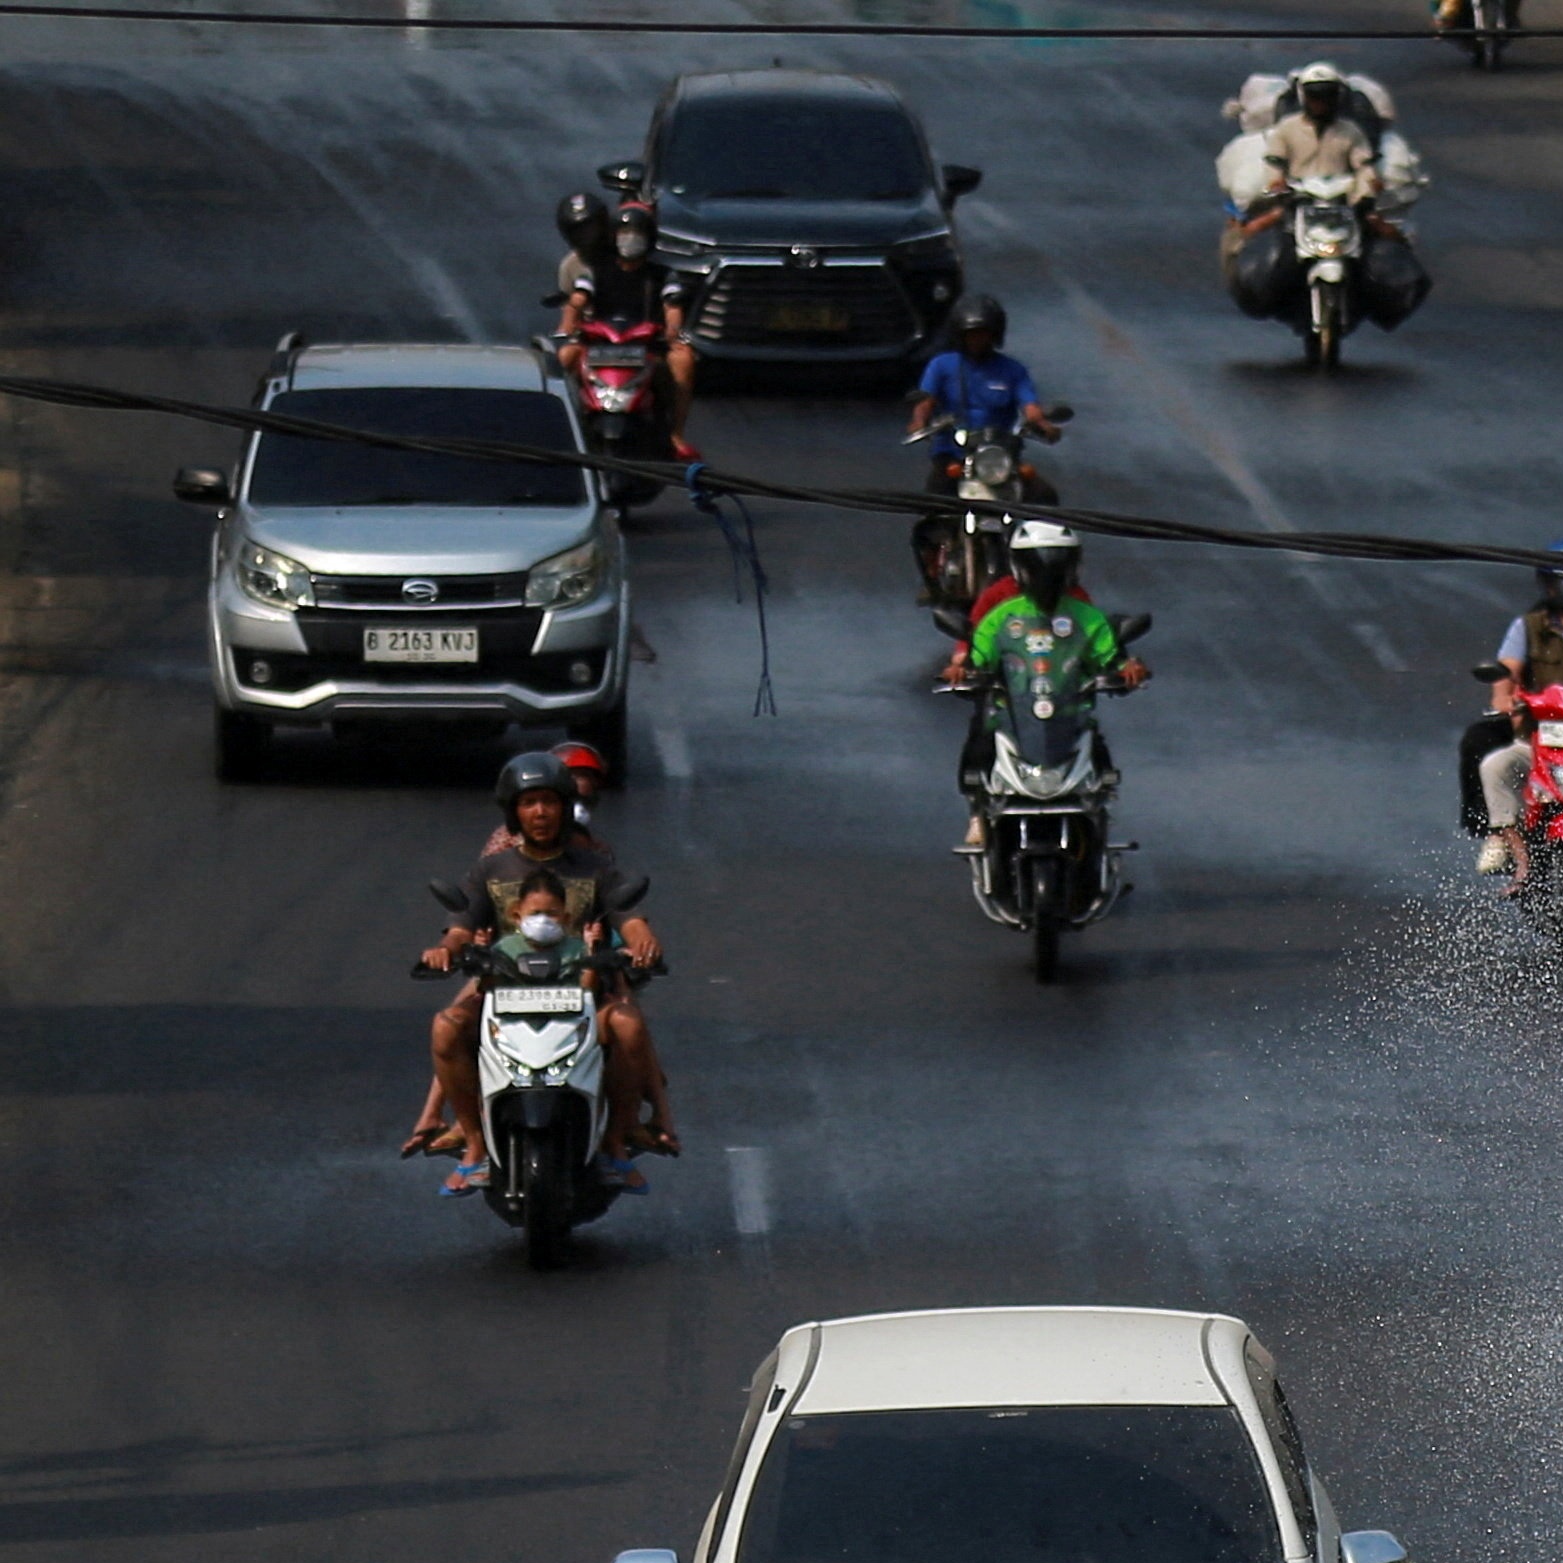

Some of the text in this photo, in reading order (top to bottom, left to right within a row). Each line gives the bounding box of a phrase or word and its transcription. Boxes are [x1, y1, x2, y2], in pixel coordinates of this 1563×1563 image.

[366, 631, 476, 651] B 2163 KVJ
